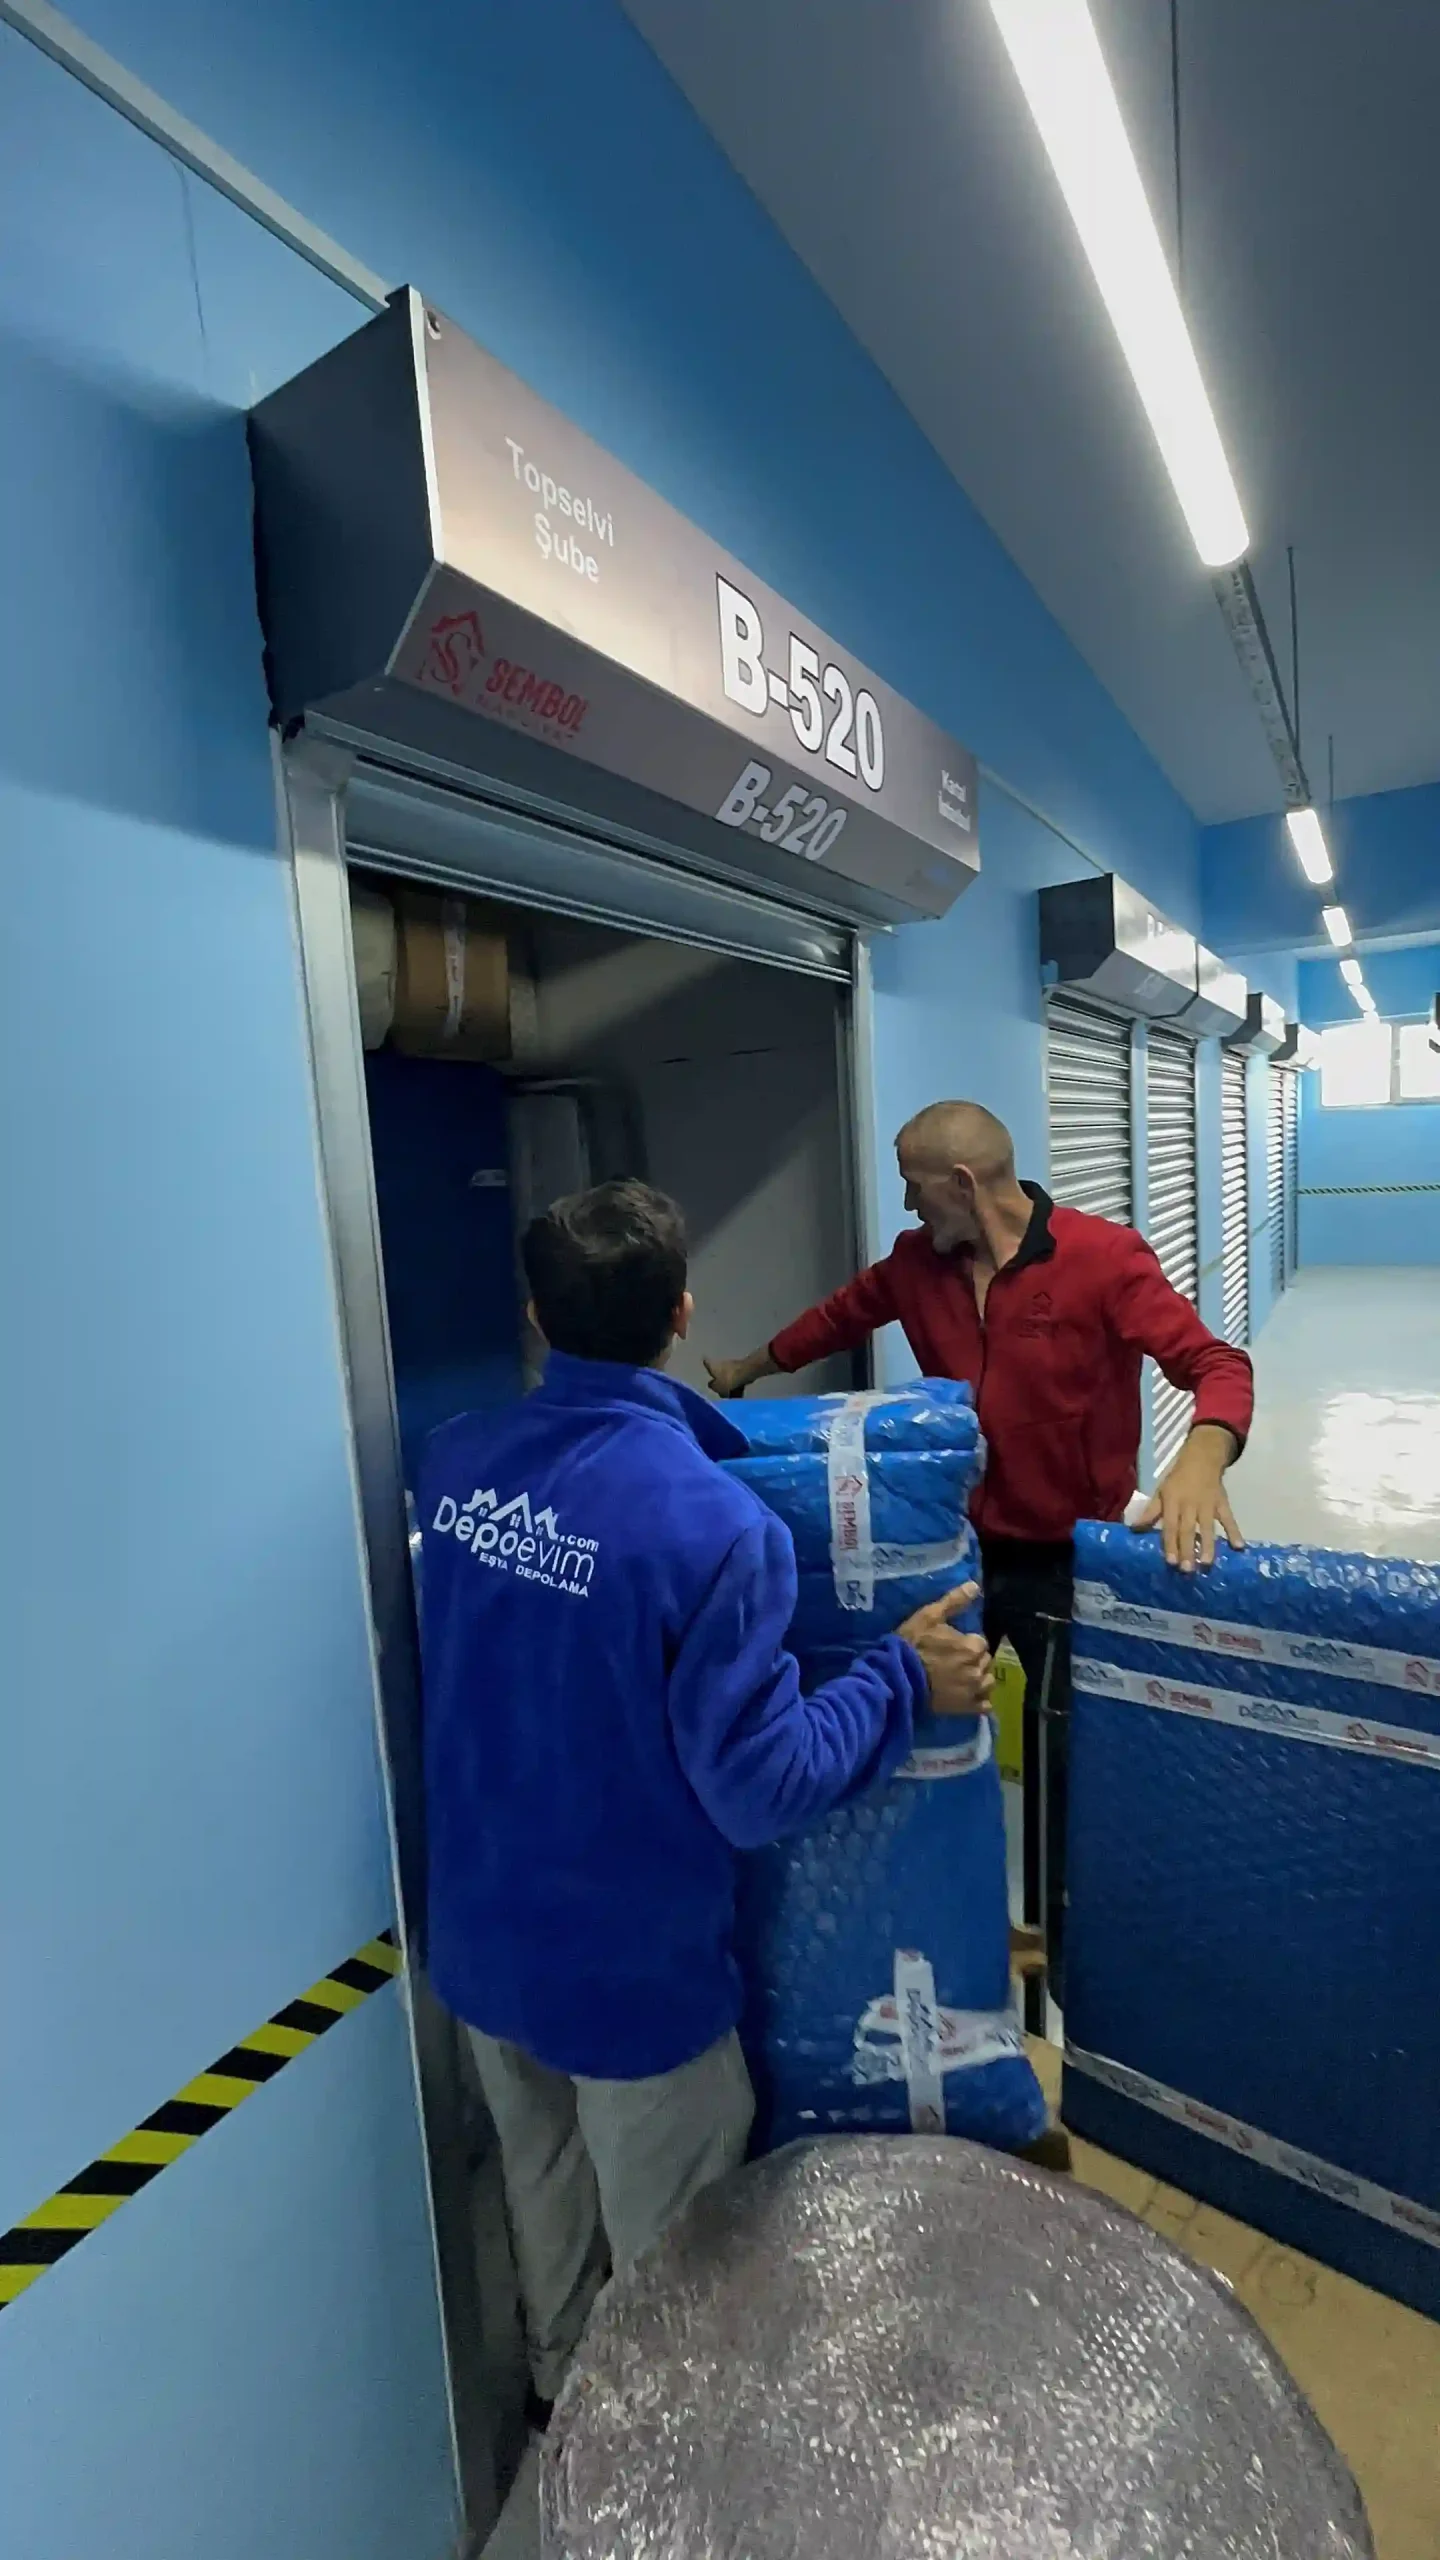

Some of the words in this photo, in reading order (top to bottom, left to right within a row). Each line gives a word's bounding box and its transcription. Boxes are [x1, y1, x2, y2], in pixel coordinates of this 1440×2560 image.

[504, 435, 614, 547] Topselvi
[534, 512, 599, 583] Şube
[485, 657, 588, 731] SEMBOL
[716, 572, 885, 792] B-520
[713, 759, 848, 862] B-520
[515, 1564, 589, 1598] DEPOLAMA
